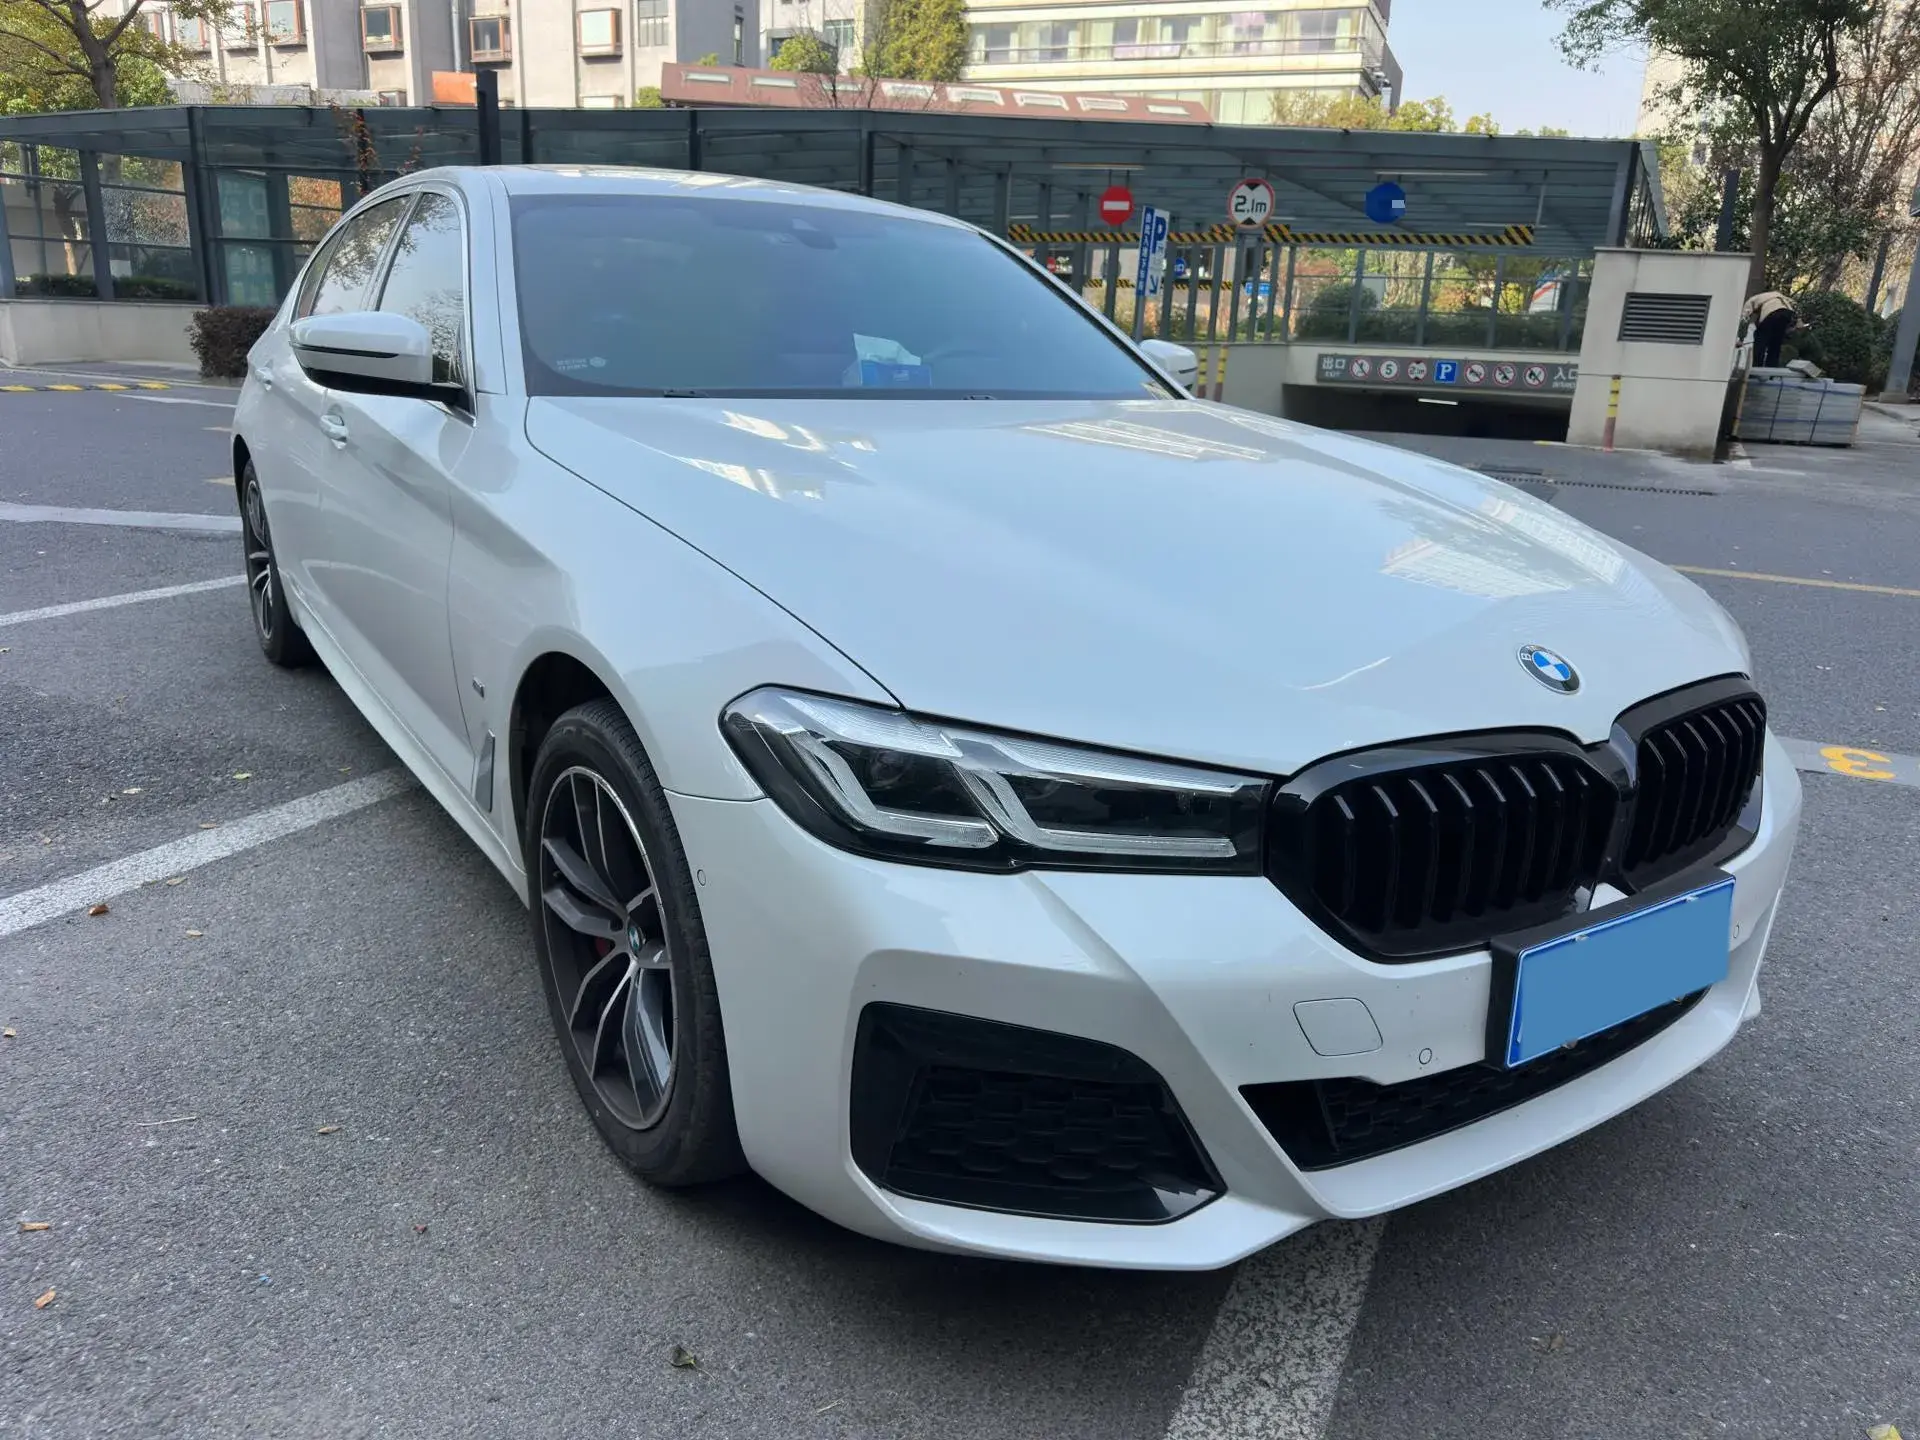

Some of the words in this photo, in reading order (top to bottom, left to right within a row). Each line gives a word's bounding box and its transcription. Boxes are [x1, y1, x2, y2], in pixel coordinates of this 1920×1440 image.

[1235, 195, 1267, 213] 2.1m
[1152, 216, 1167, 254] P
[1322, 357, 1346, 370] 出口
[1385, 363, 1393, 375] 5
[1439, 363, 1453, 380] P
